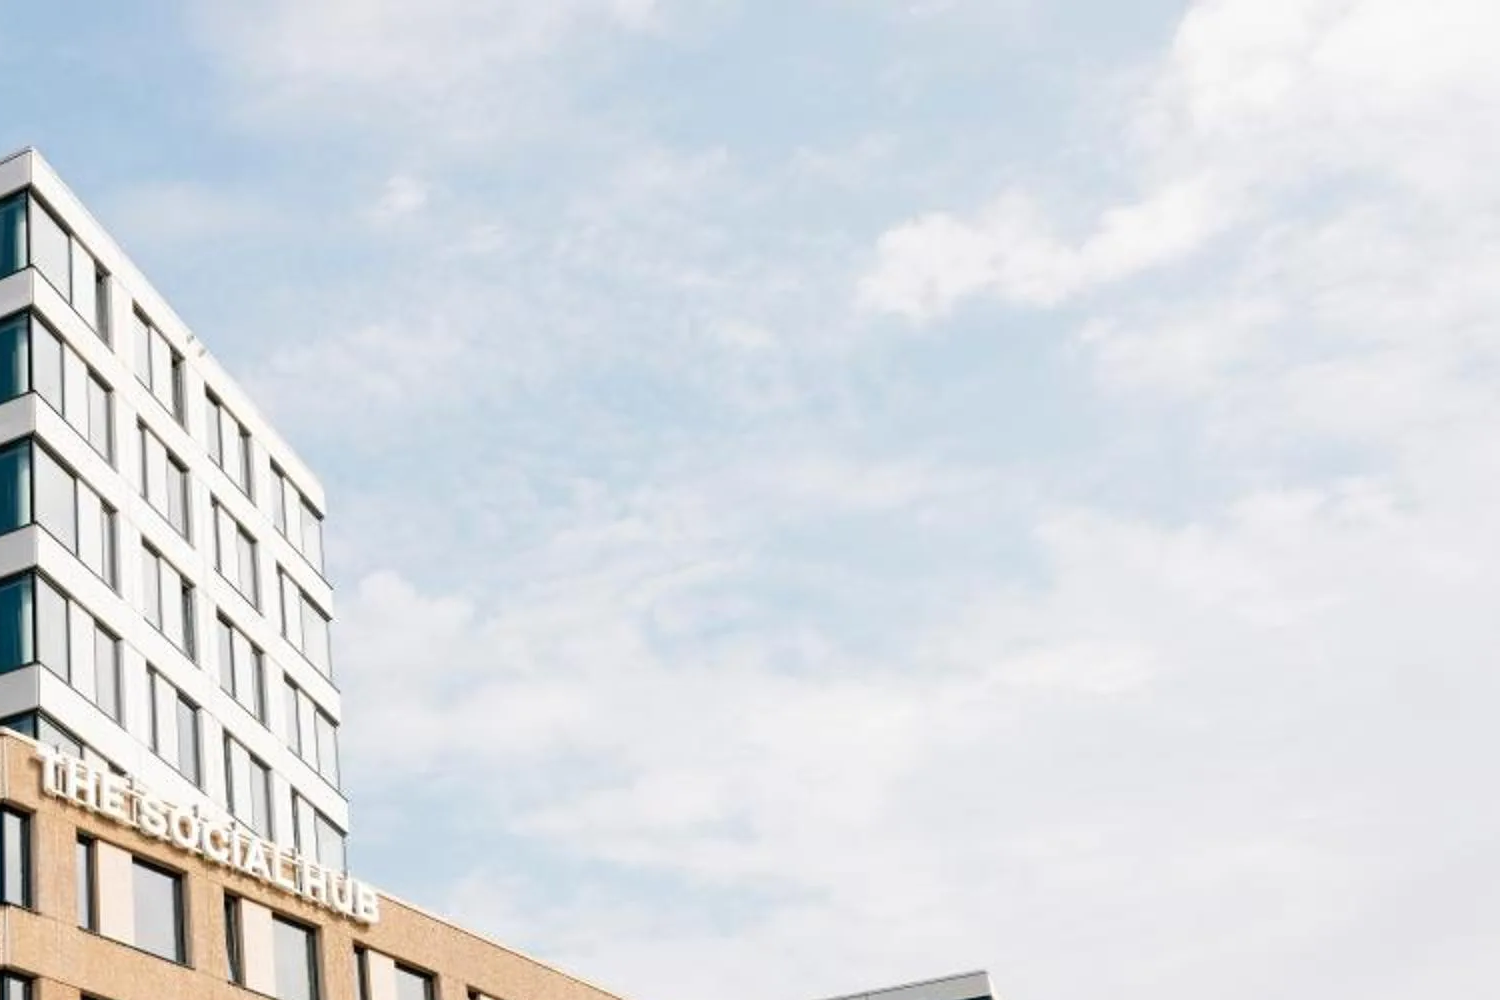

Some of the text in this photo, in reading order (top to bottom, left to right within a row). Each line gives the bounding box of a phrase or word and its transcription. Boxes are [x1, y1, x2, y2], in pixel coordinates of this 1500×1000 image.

[36, 742, 380, 924] THE SOCIAL HUB
